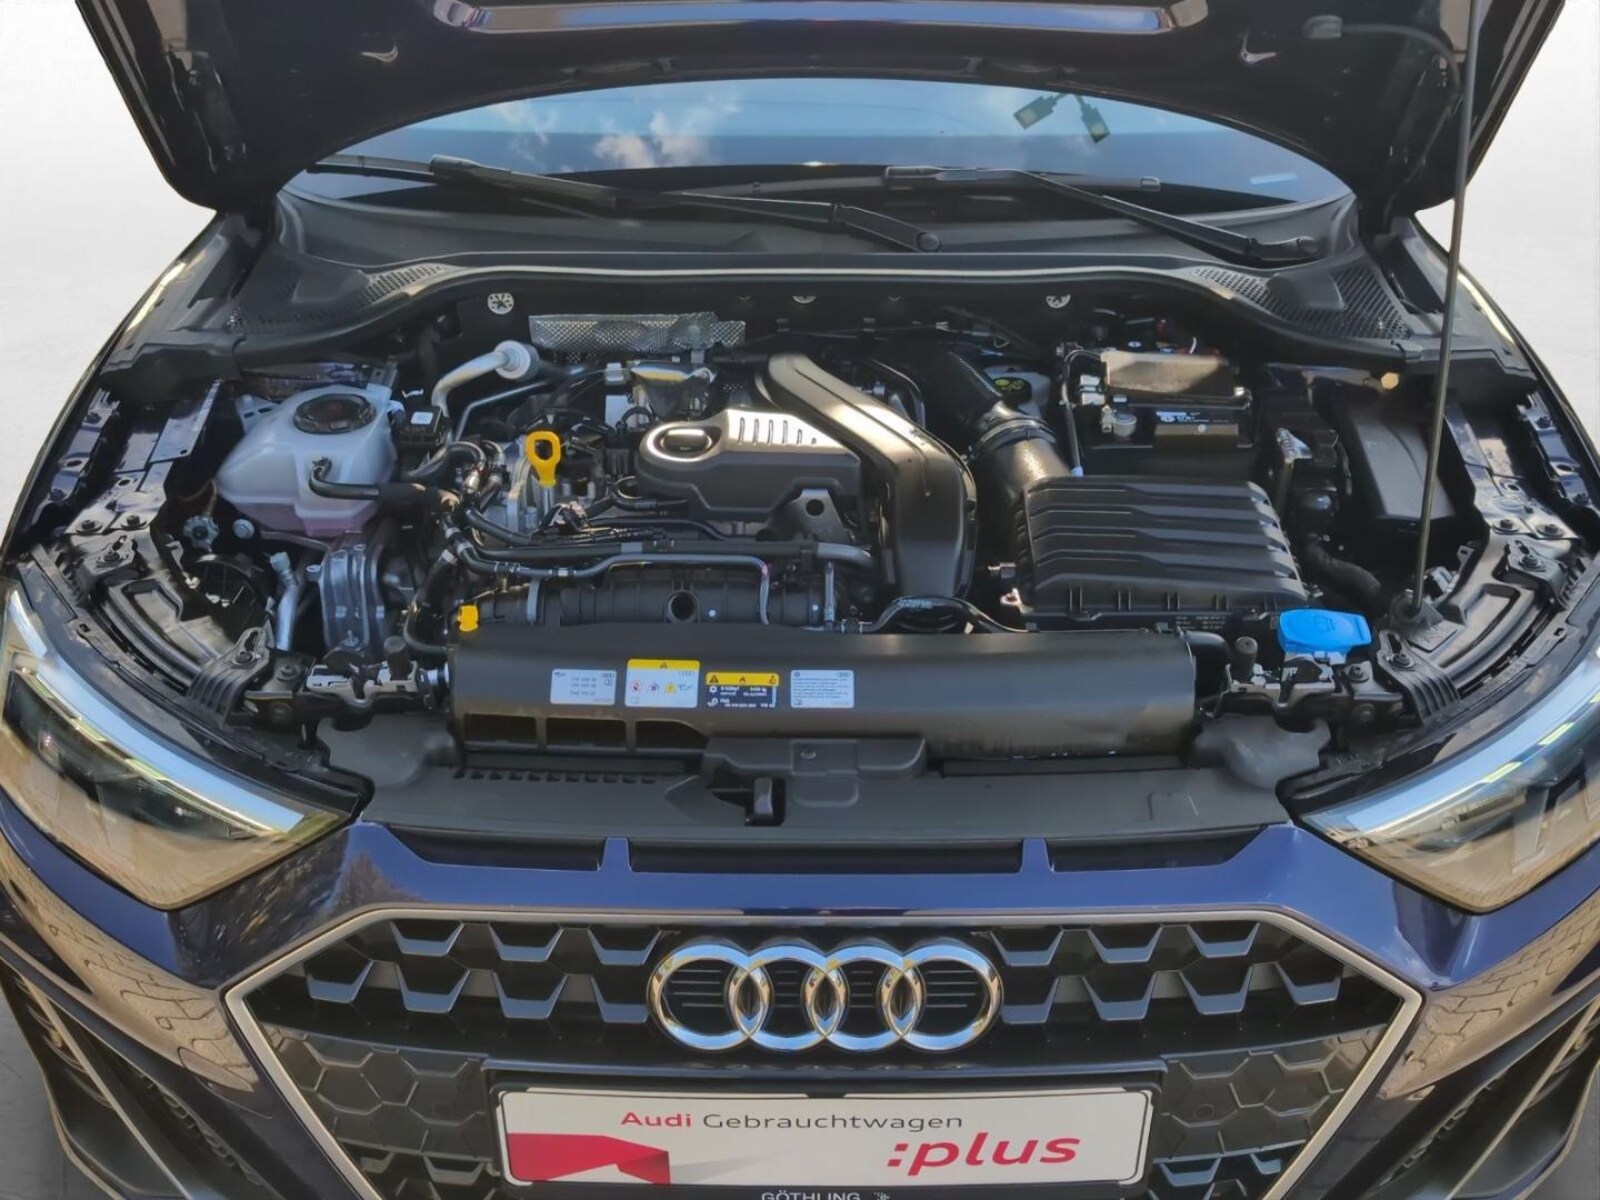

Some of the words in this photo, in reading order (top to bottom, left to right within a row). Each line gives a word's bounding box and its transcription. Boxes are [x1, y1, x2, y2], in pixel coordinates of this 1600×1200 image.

[620, 1112, 692, 1128] Audi
[703, 1113, 964, 1132] Gebrauchtwagen
[887, 1132, 1080, 1176] :plus
